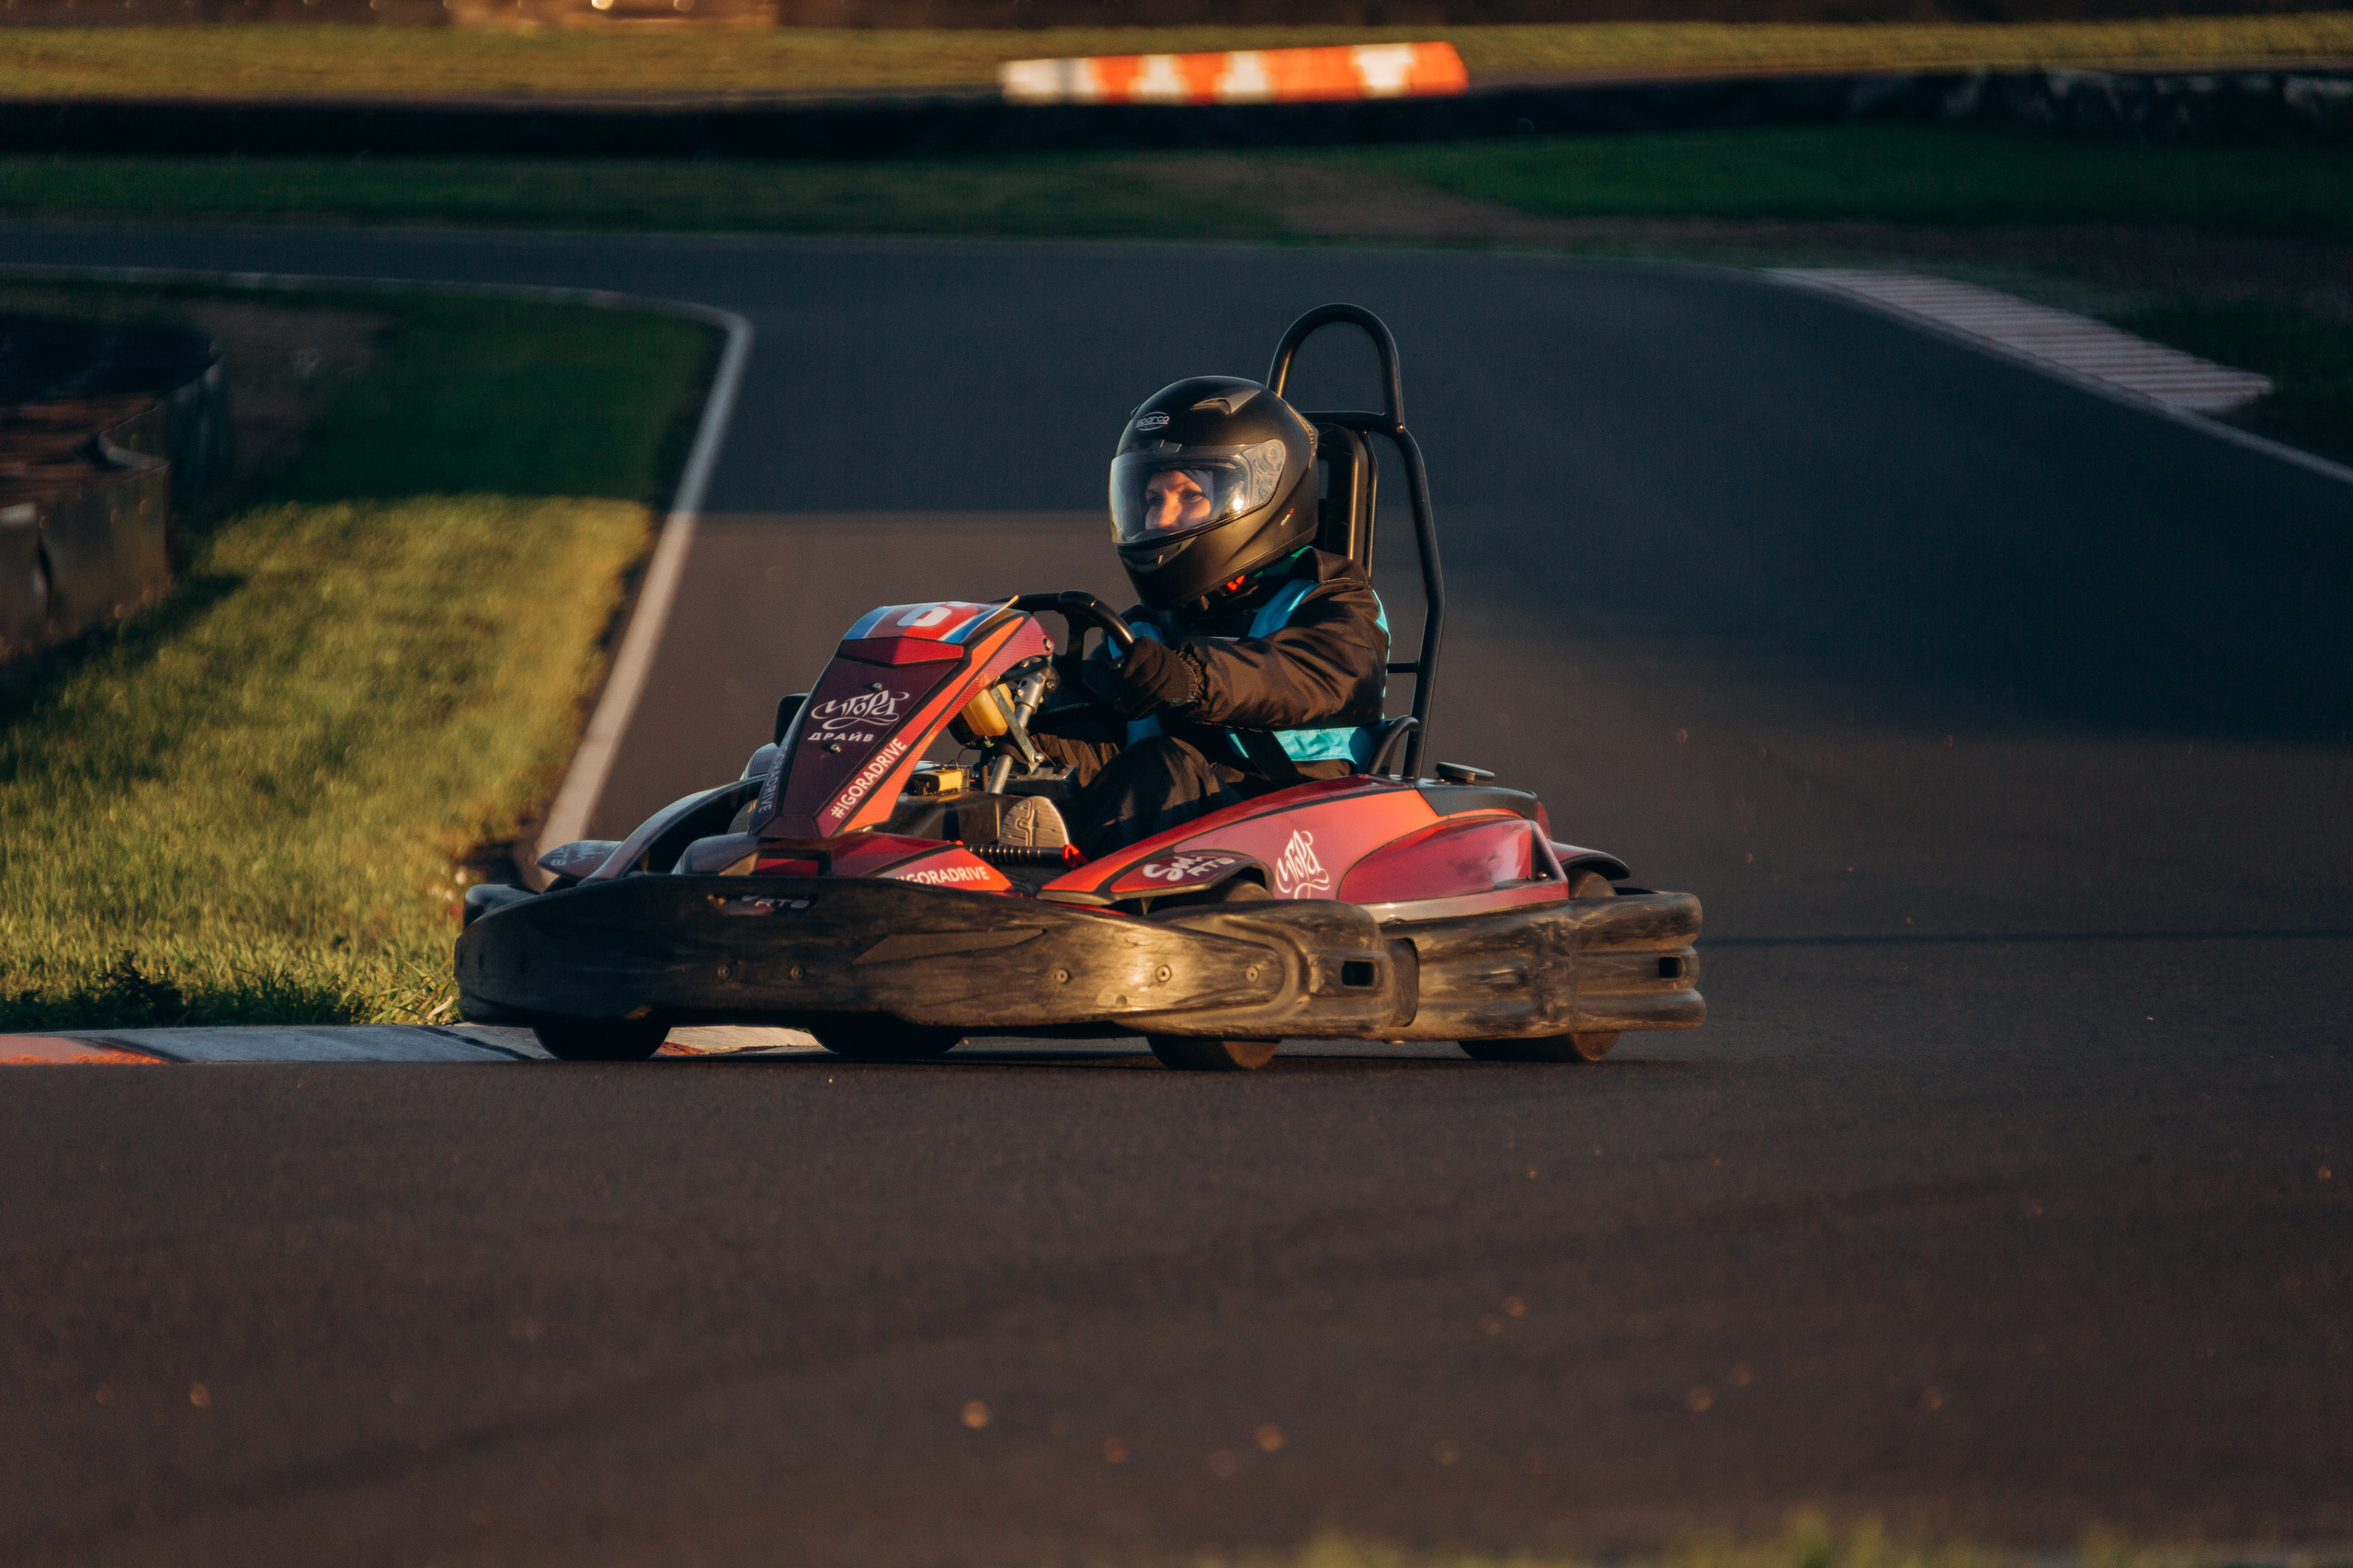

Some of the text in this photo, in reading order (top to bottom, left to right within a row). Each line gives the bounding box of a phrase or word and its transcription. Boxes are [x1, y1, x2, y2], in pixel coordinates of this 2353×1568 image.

[807, 731, 875, 743] ДРАЙВ
[830, 737, 907, 819] #IGORADRIVE
[895, 866, 991, 885] GORADRIVE
